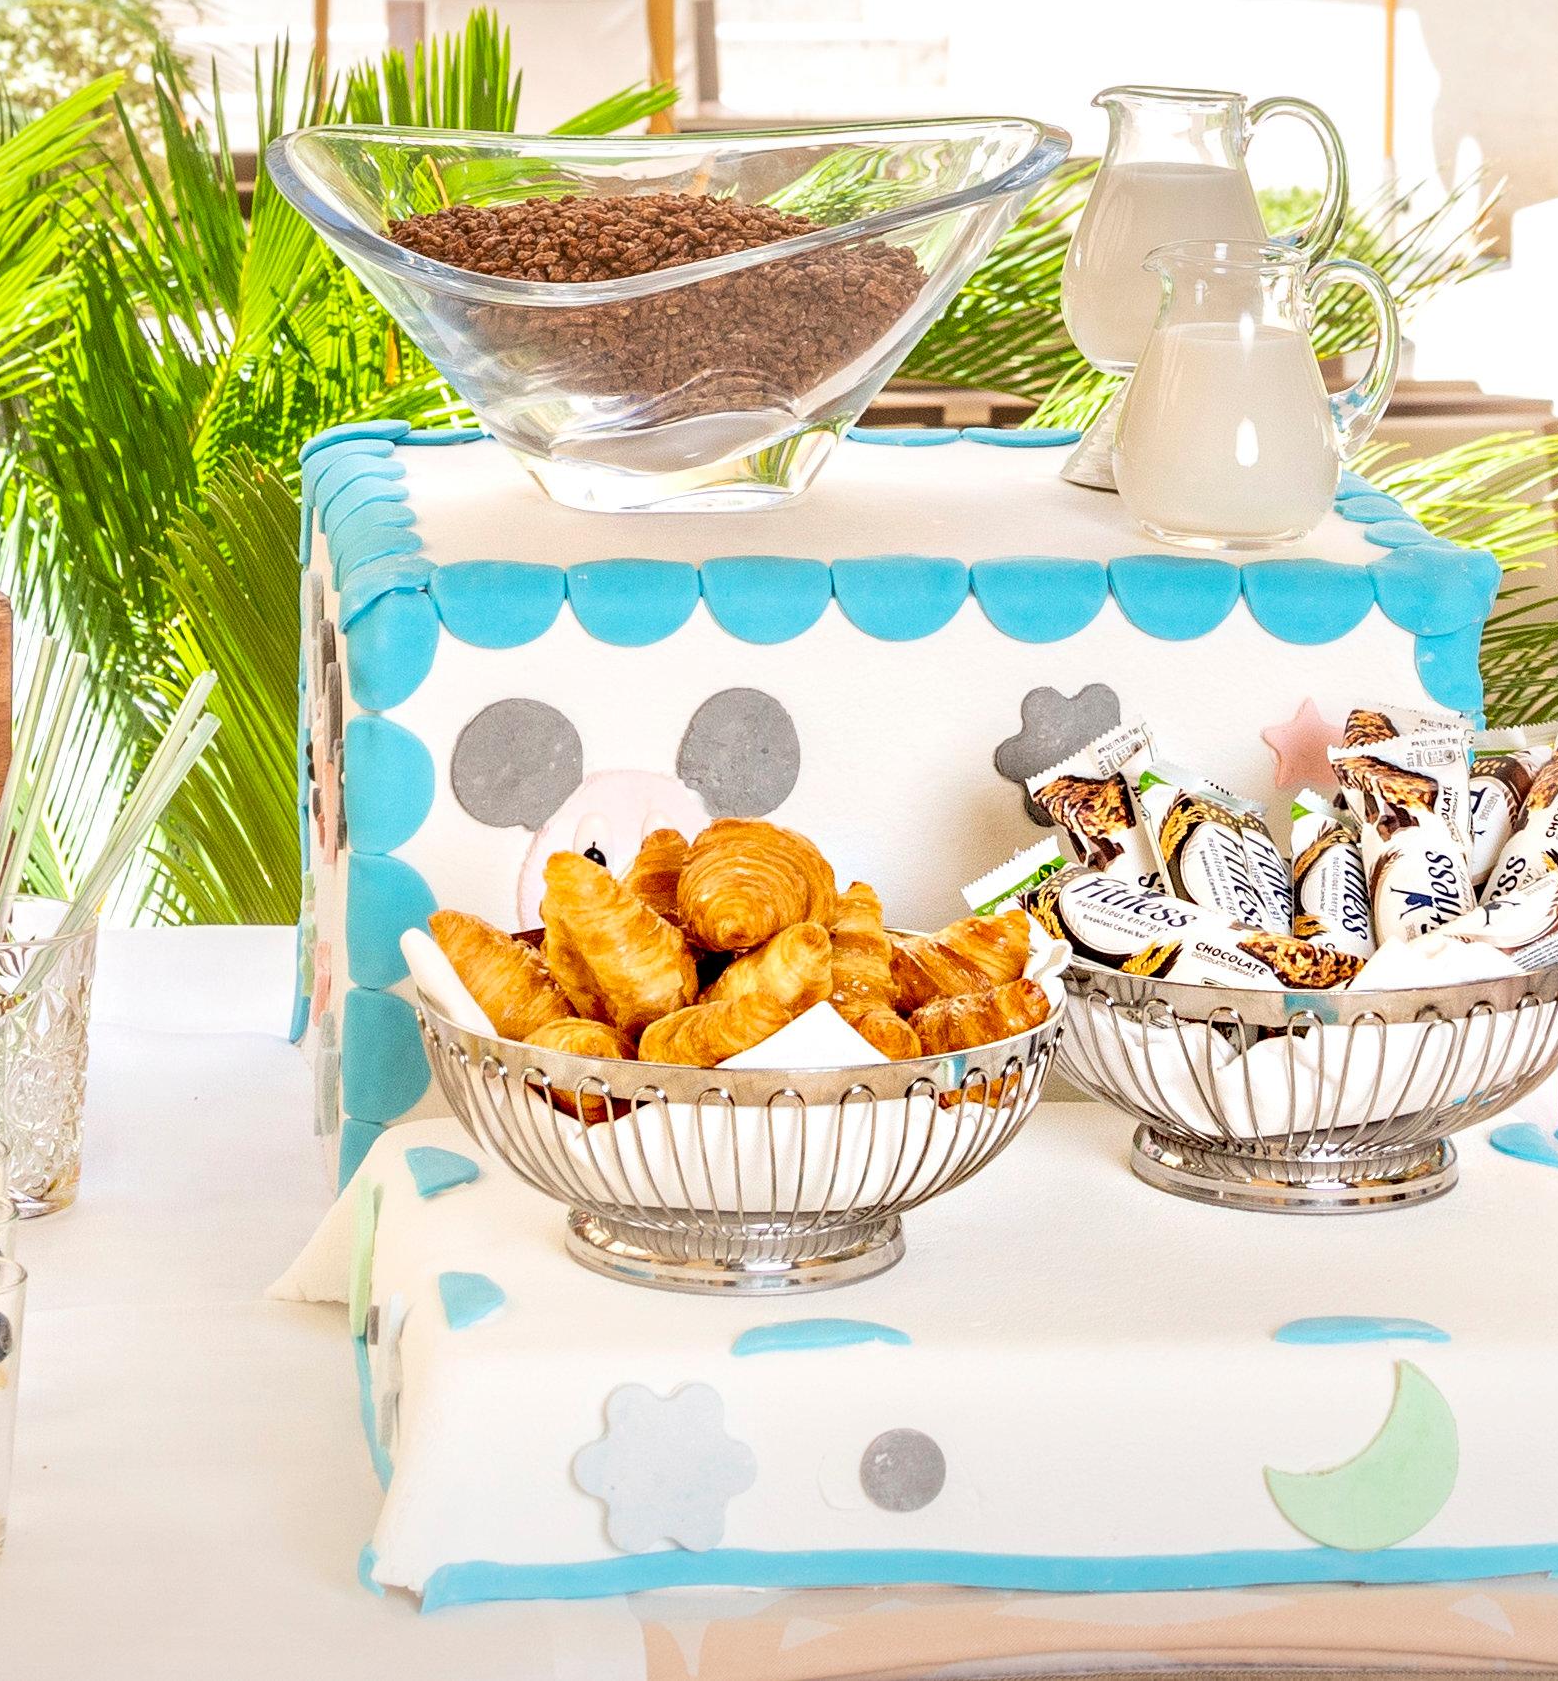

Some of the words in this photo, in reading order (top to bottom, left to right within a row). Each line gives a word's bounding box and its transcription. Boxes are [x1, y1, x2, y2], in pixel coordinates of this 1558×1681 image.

[1071, 876, 1197, 927] Fitness
[1244, 835, 1292, 929] Fitnes
[1420, 850, 1461, 934] tness
[1075, 899, 1124, 920] nutritious
[1195, 941, 1268, 976] CHOCOLATE
